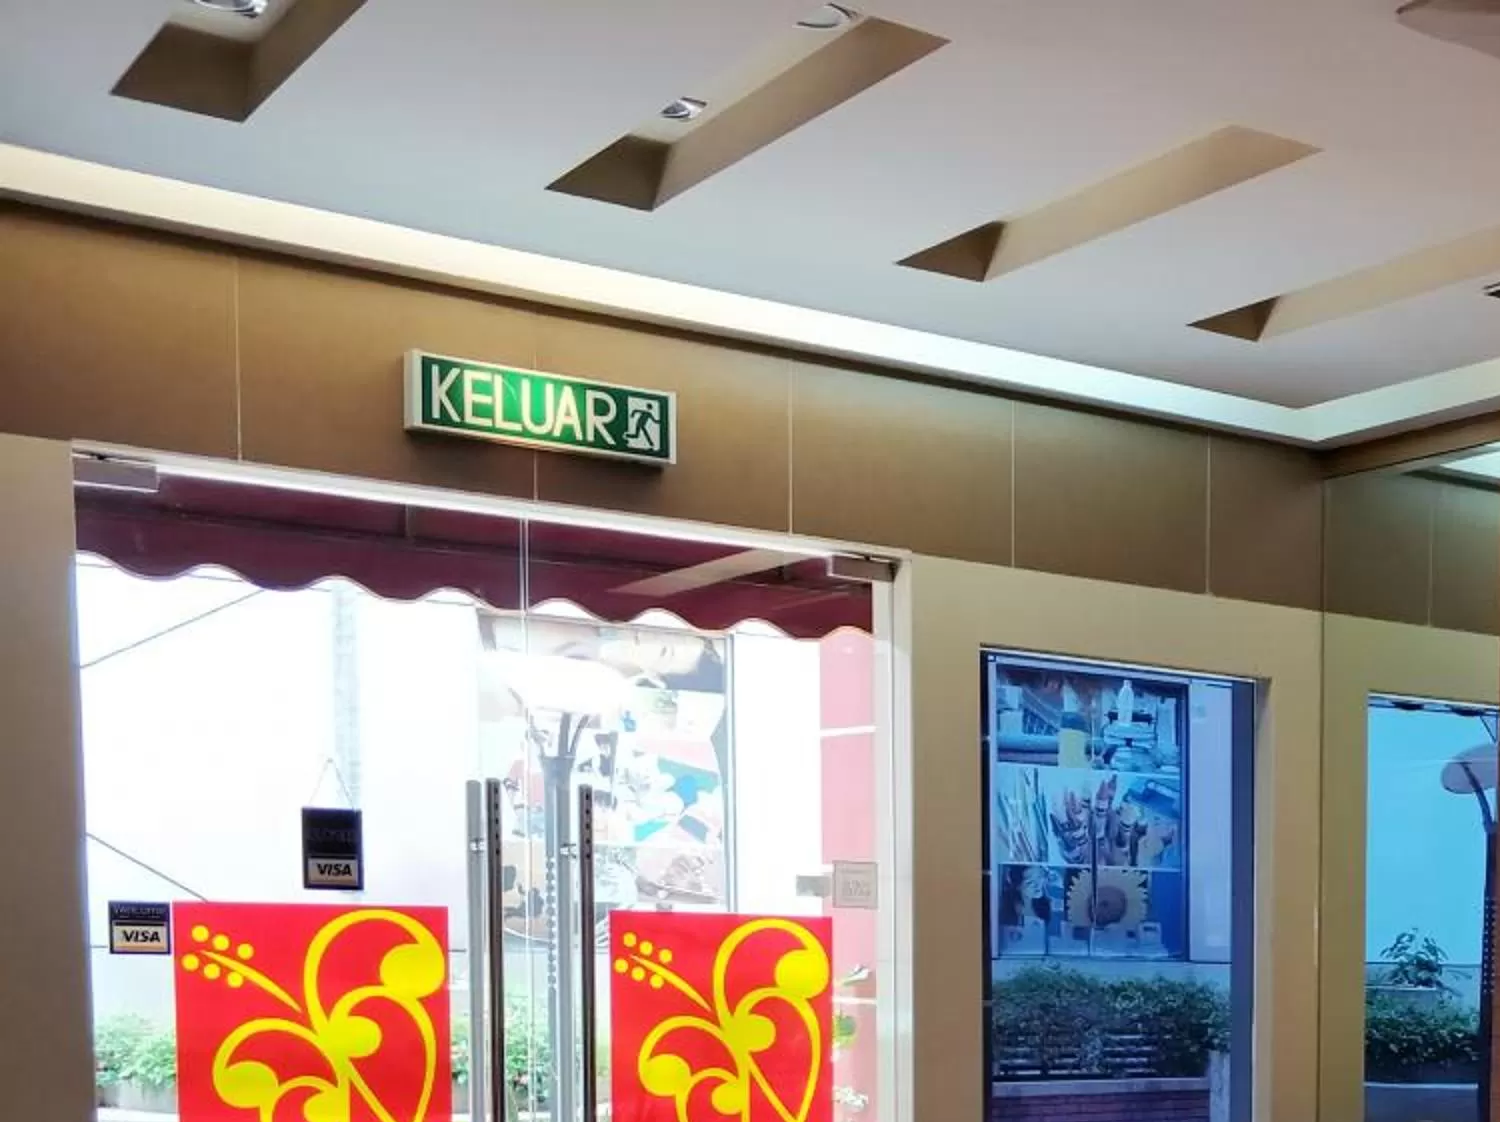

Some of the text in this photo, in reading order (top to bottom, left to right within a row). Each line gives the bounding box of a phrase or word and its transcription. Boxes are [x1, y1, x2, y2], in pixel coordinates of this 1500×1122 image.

[431, 364, 617, 445] KELUAR
[316, 862, 353, 877] VISA
[122, 929, 161, 943] VISA
